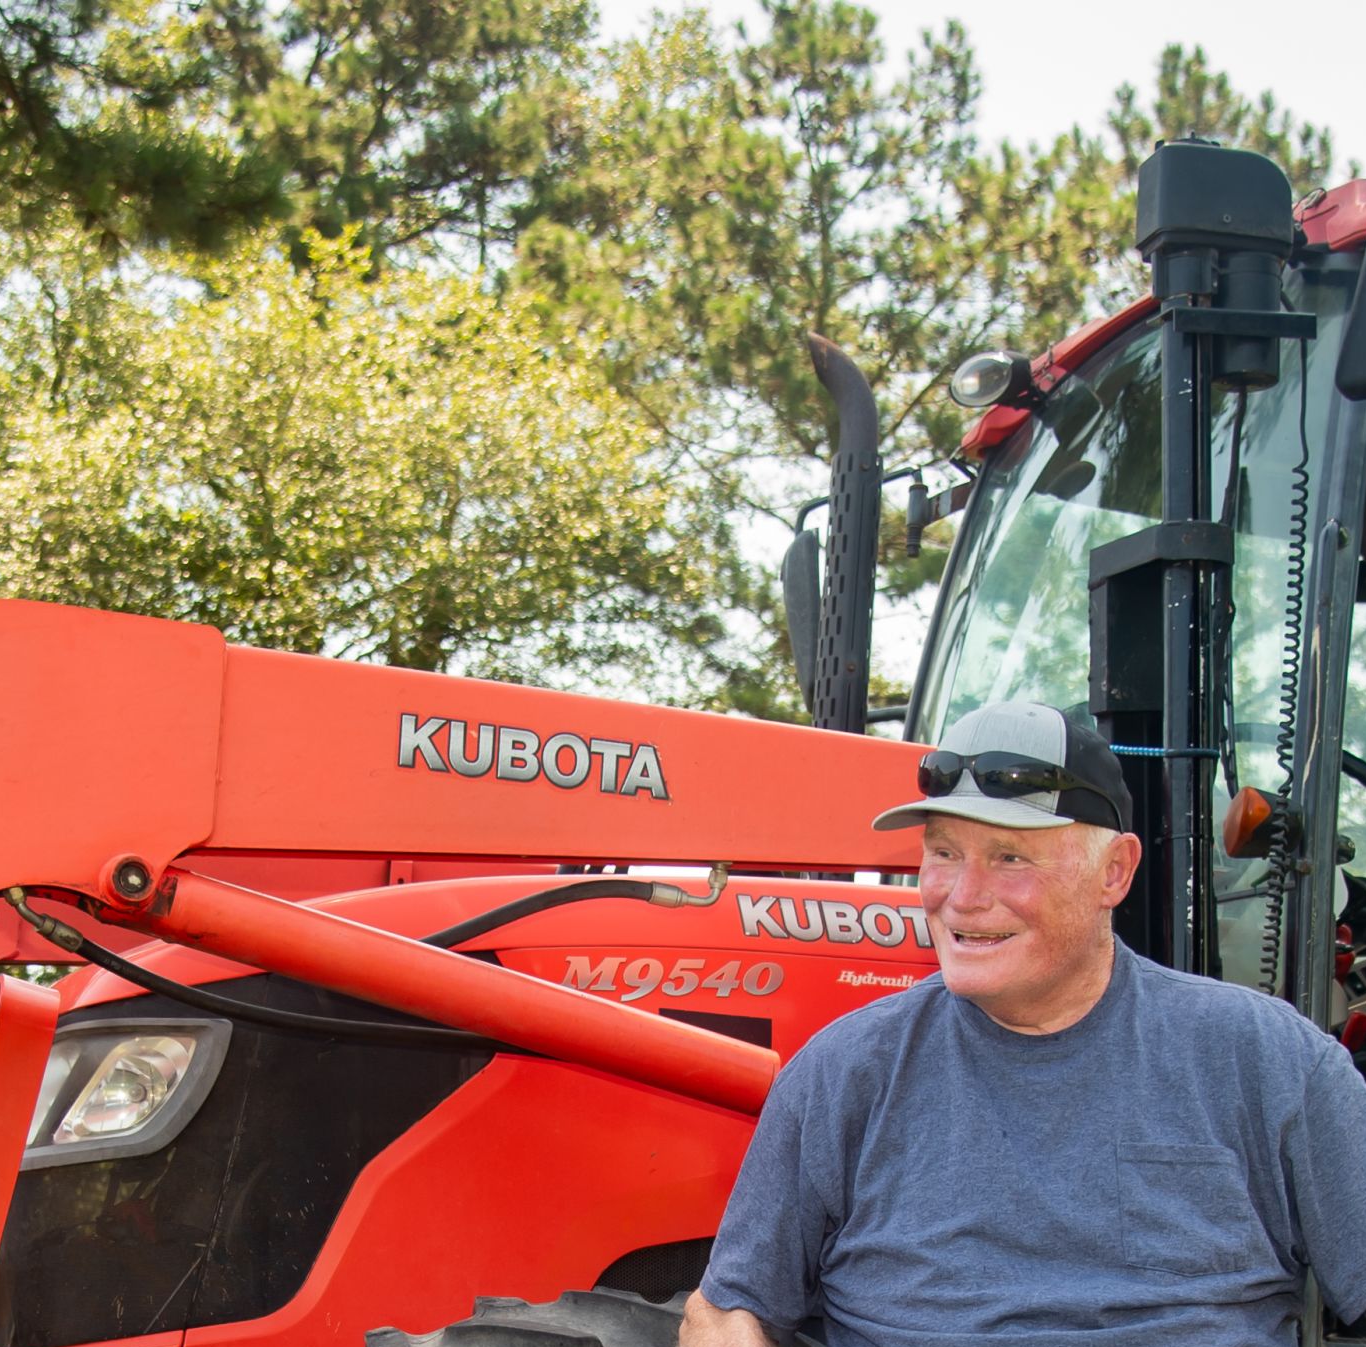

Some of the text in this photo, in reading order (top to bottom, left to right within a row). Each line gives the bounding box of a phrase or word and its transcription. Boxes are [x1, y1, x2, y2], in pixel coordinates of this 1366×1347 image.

[398, 713, 670, 800] KUBOTA
[736, 894, 934, 949] KUBOT
[559, 955, 785, 1002] M9540
